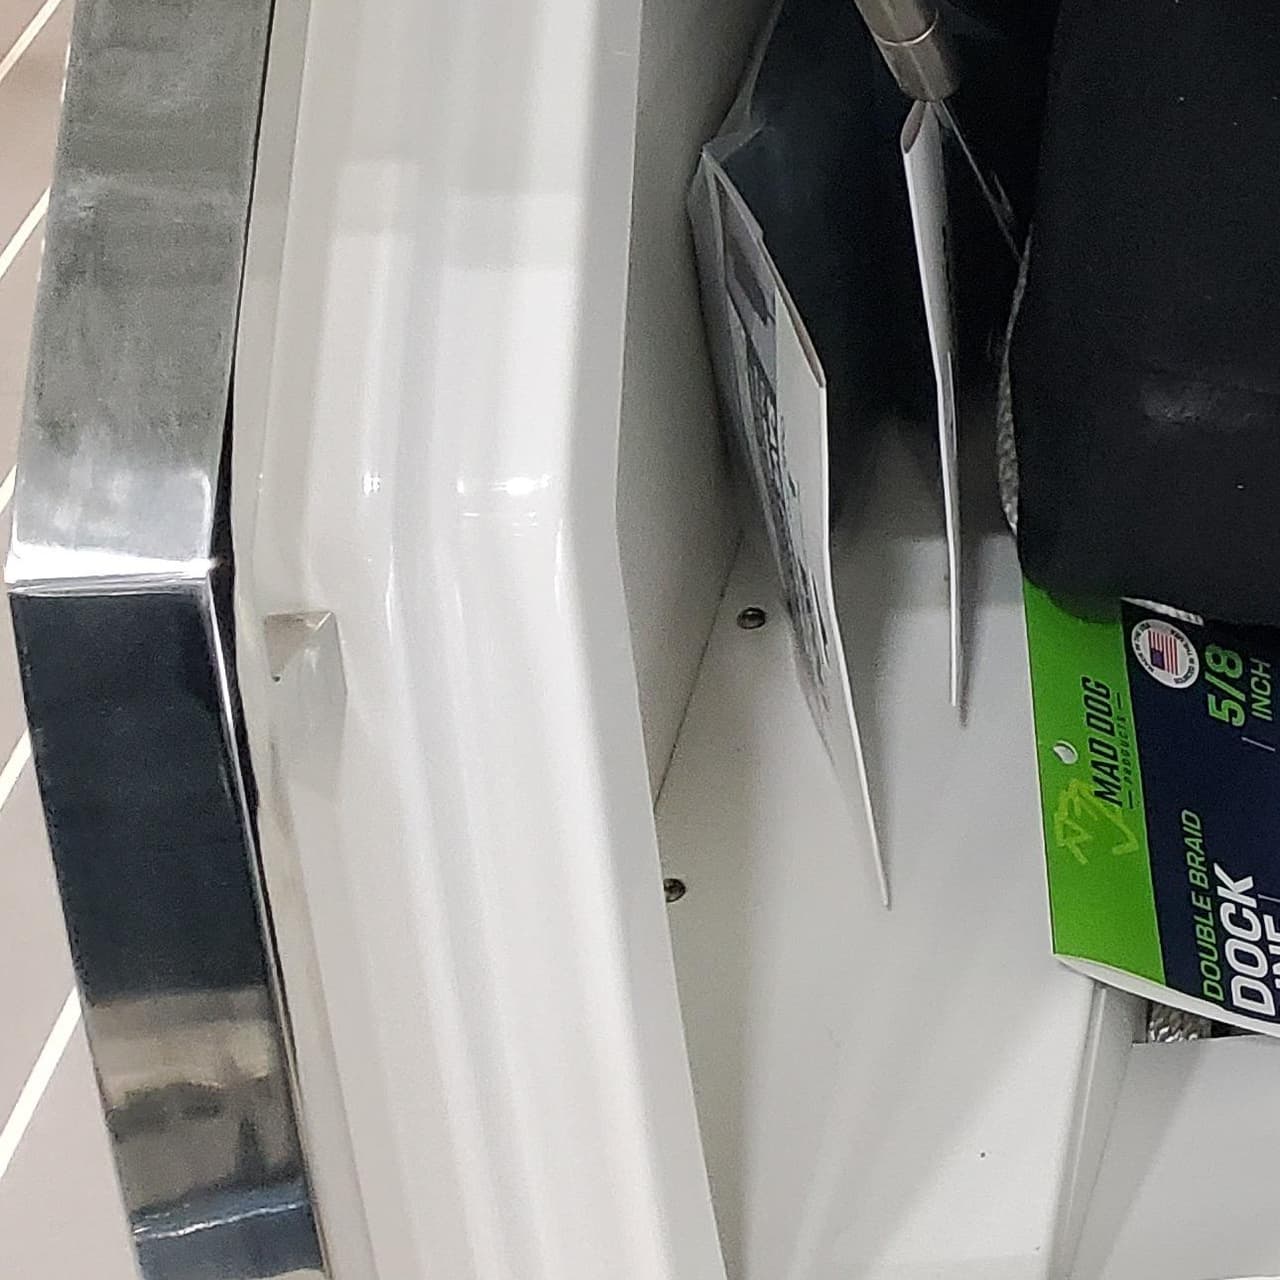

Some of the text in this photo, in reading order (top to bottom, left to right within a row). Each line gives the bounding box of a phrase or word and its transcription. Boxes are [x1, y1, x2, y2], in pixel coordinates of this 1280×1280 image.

[1204, 643, 1247, 728] 5/8
[1250, 657, 1273, 722] INCH
[1081, 675, 1123, 808] MAD DOG
[1117, 715, 1133, 785] PRODUCTS
[1181, 809, 1225, 1002] DOUBLE BRAID
[1213, 862, 1276, 1017] DOCK
